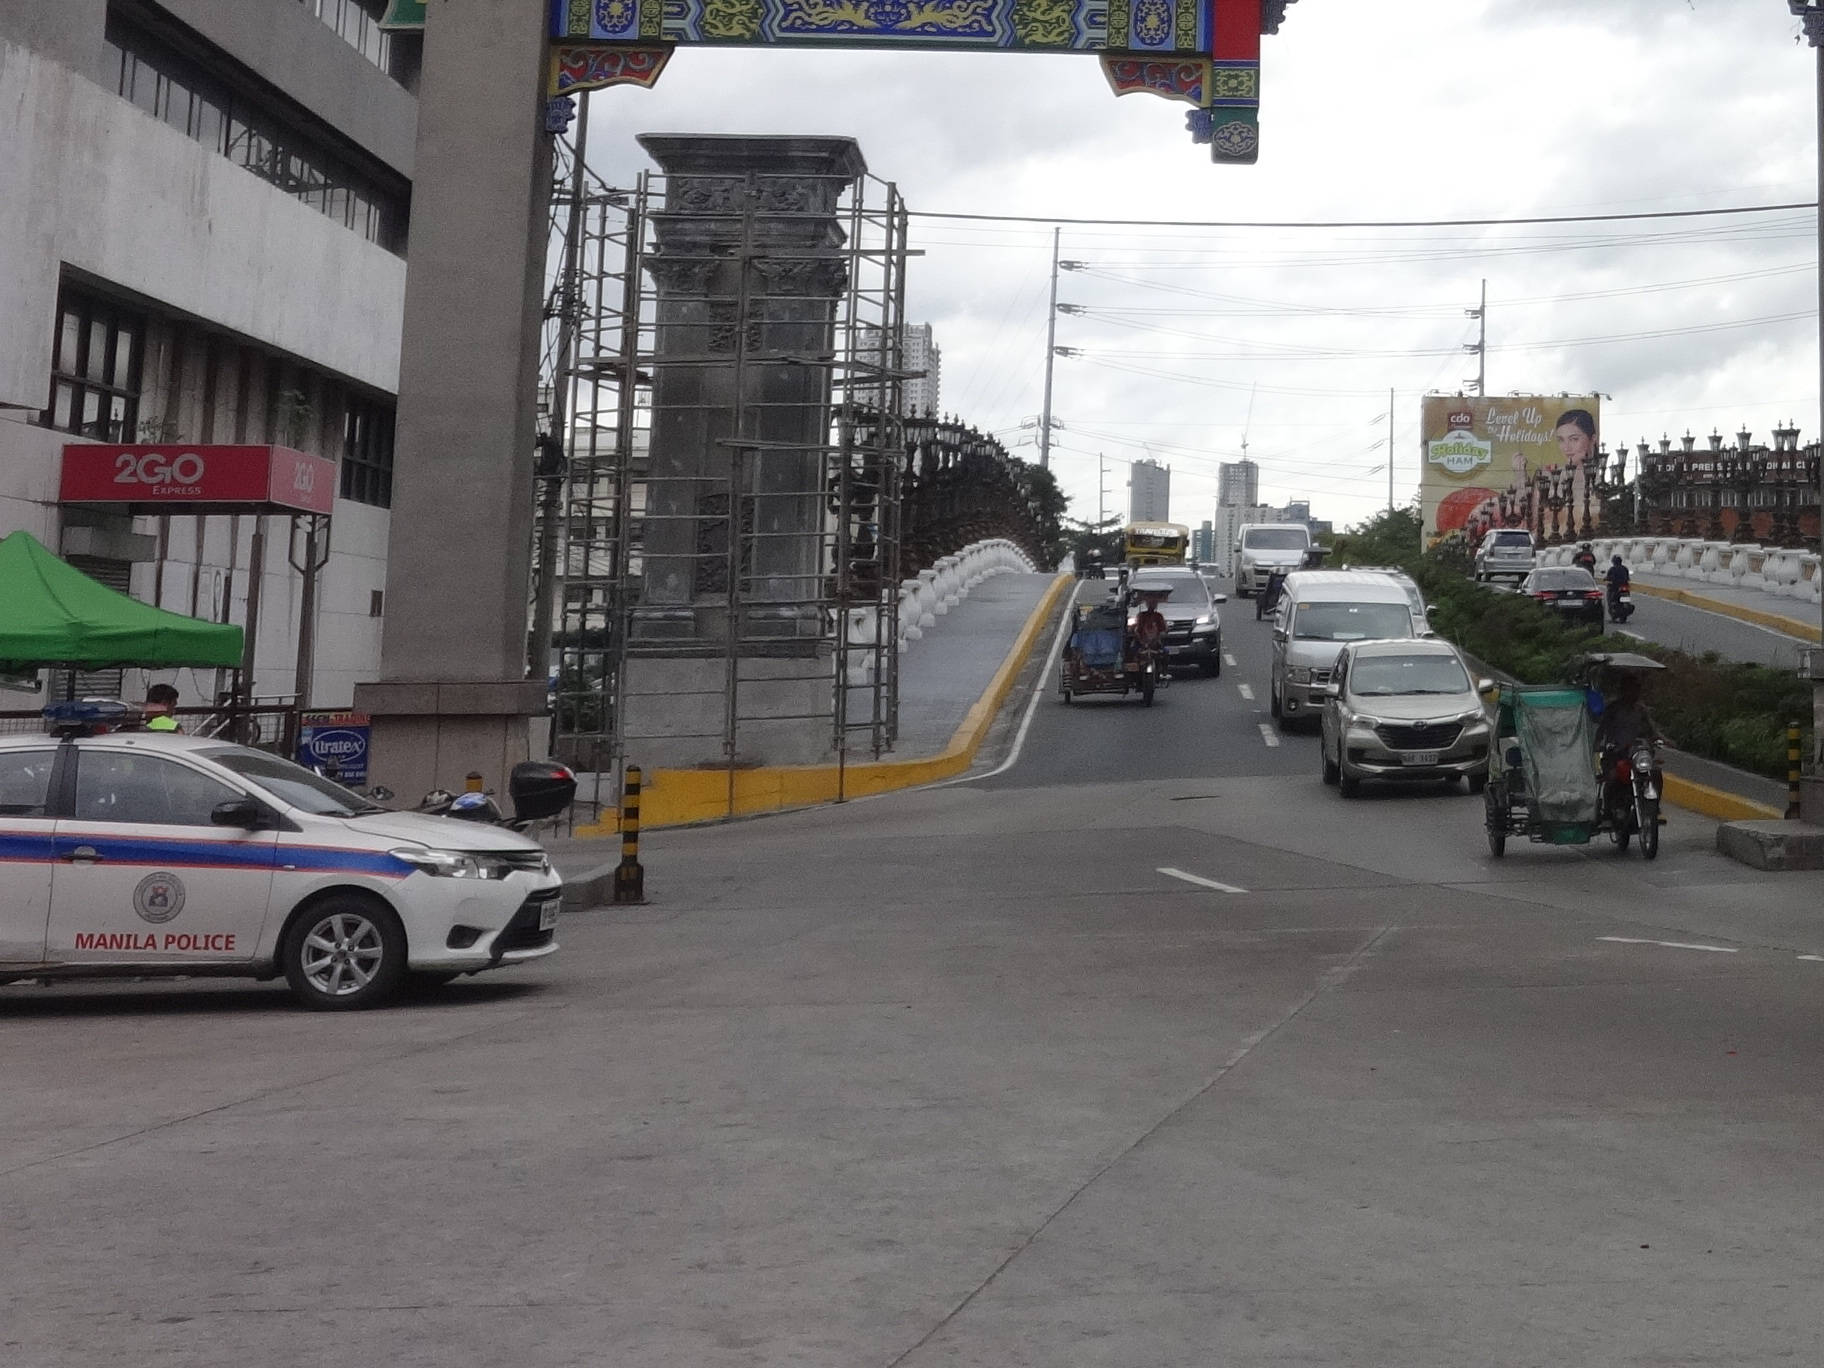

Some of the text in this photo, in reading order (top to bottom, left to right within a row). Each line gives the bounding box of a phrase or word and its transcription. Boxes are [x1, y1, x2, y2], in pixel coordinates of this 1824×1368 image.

[1450, 412, 1471, 423] cdo
[1486, 406, 1544, 428] Level Up
[1431, 442, 1489, 460] Holiday
[113, 453, 204, 484] 2GO
[1446, 456, 1474, 465] HAM
[314, 740, 362, 754] Uratex
[74, 933, 236, 951] MANILA POLICE
